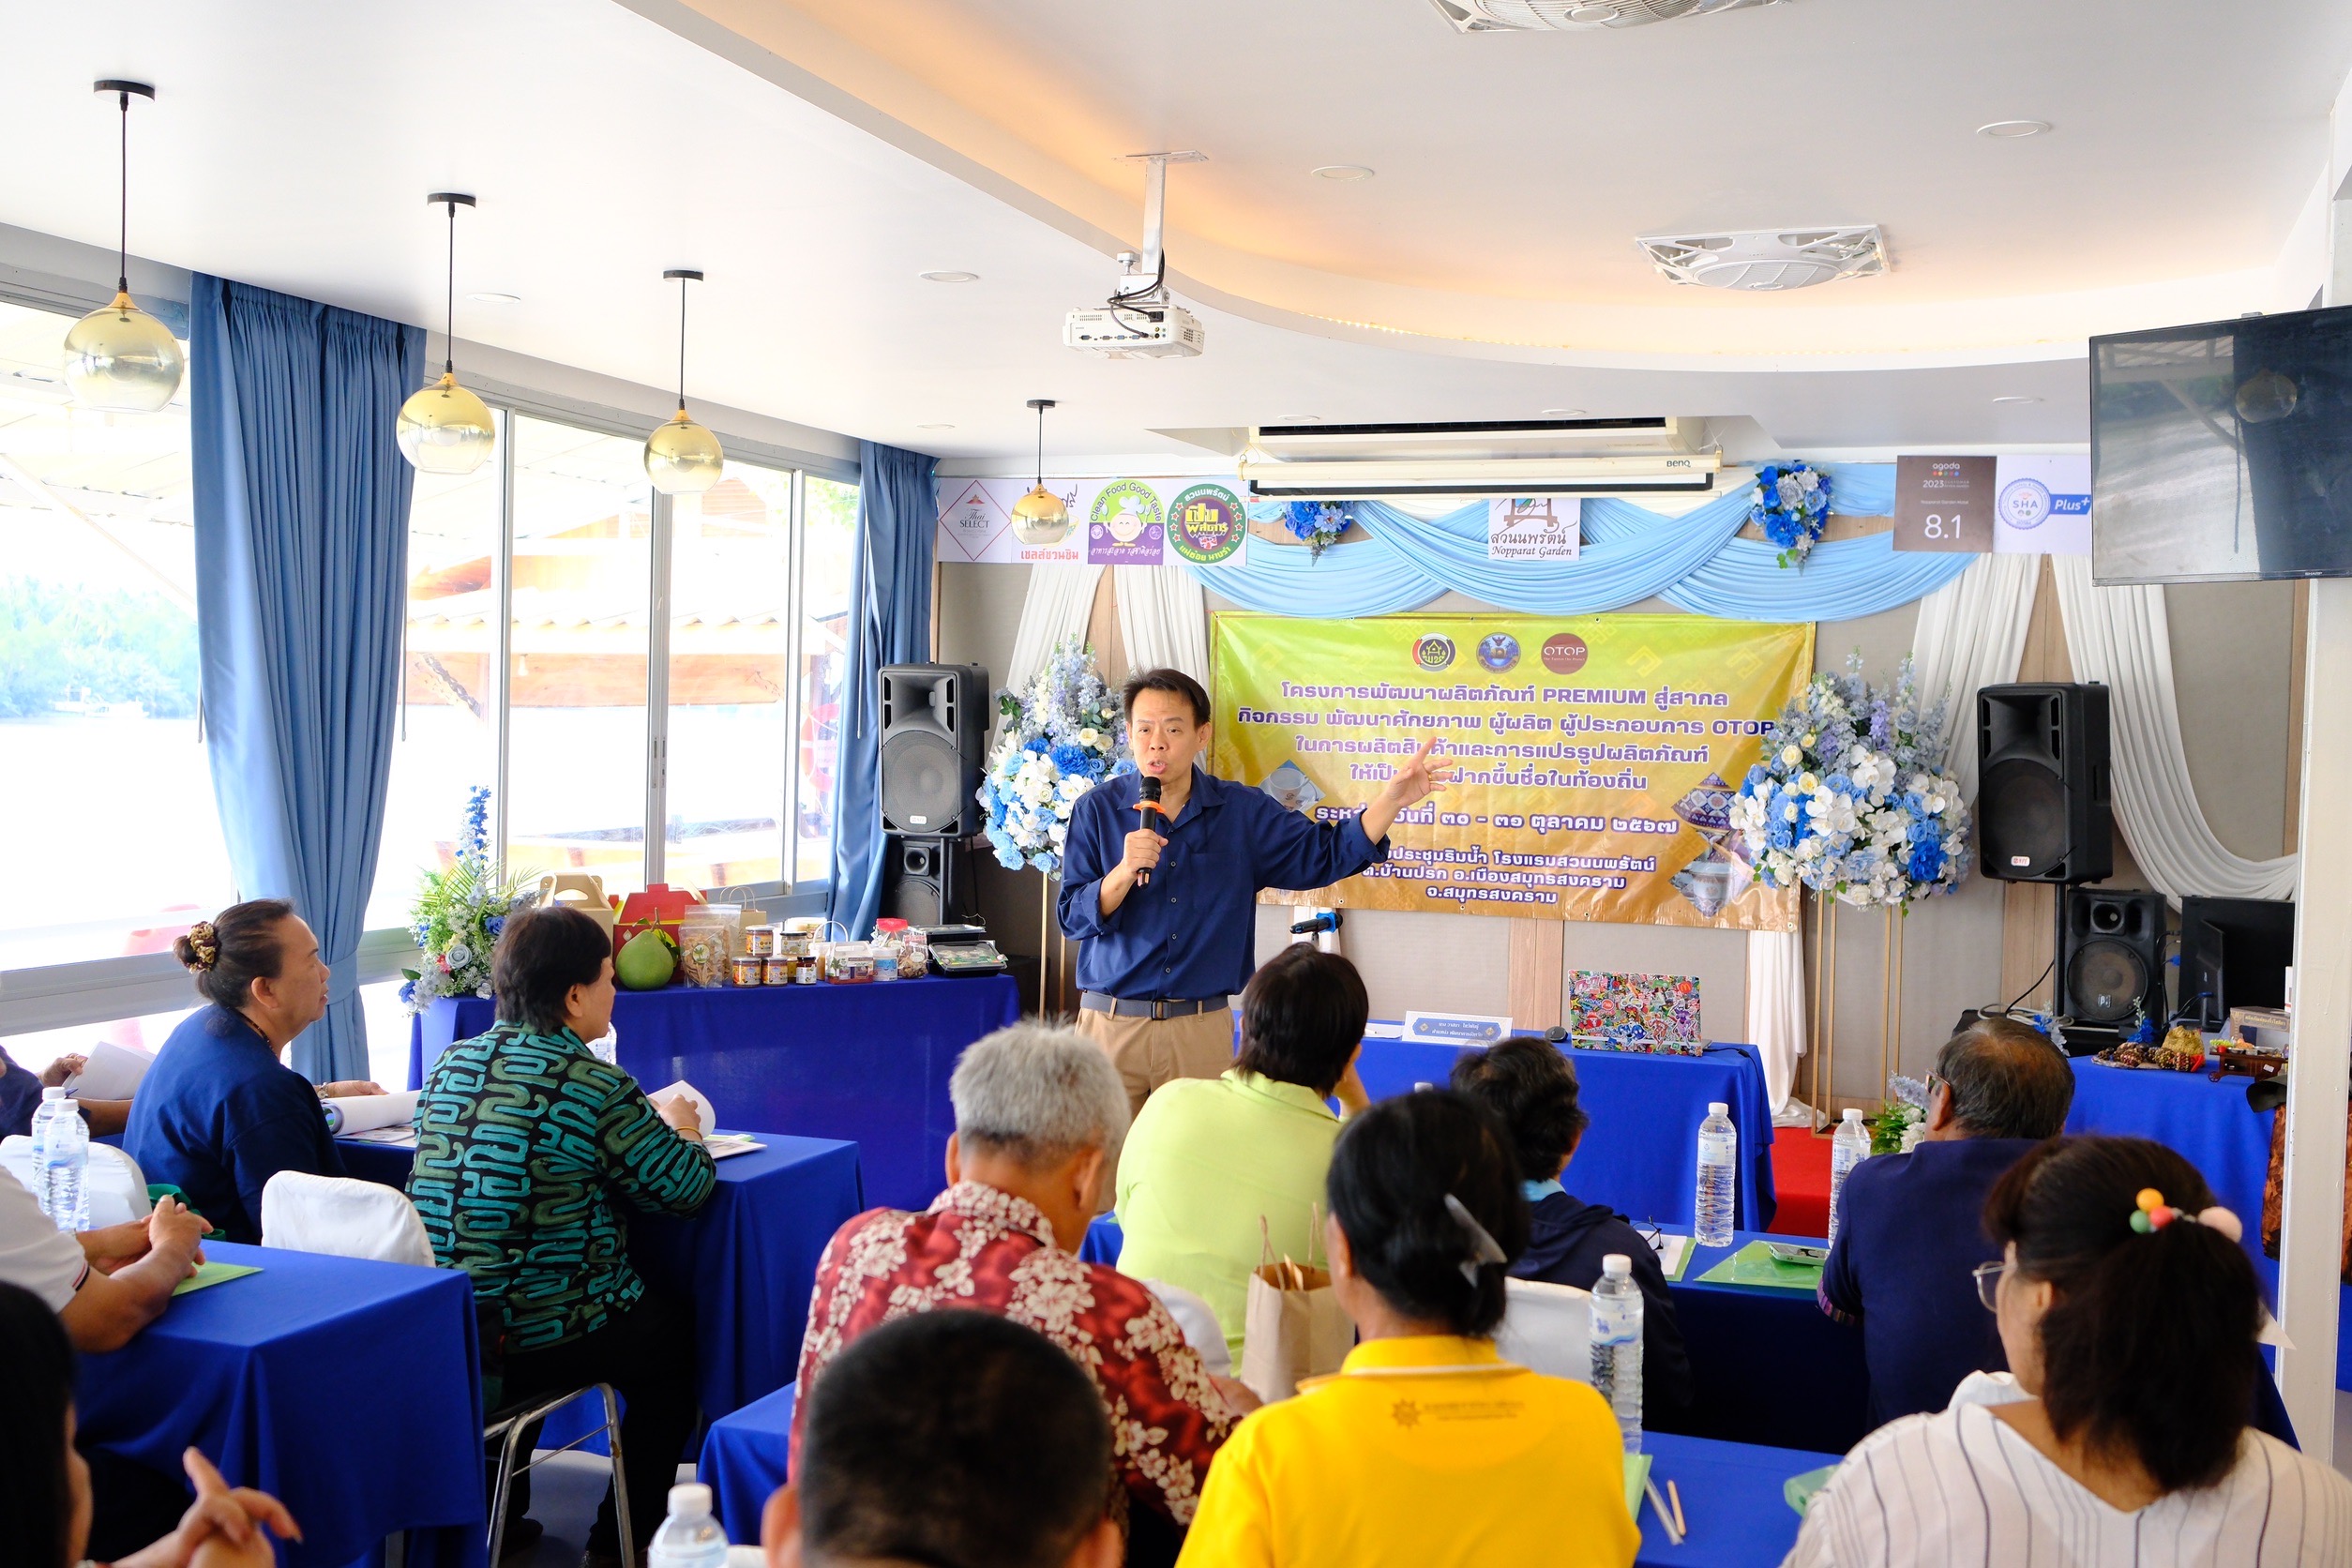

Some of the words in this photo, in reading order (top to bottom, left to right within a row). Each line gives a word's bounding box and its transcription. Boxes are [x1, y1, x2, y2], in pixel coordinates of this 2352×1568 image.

[1932, 462, 1961, 471] agoda
[1090, 496, 1107, 521] Clean
[1106, 481, 1127, 497] Food
[1129, 481, 1152, 499] Good
[1149, 495, 1162, 521] Taste
[2013, 500, 2039, 508] SHA
[966, 508, 986, 520] Thai
[959, 520, 990, 529] SELECT
[1924, 513, 1962, 539] 8.1
[1490, 528, 1568, 546] สวนนพรัตน์
[1020, 548, 1079, 561] เชลล์ชวนชิม
[1491, 545, 1536, 559] Nopparat
[1538, 545, 1573, 559] Garden
[1544, 646, 1586, 656] OTOP
[1281, 680, 1536, 703] โครงการพัฒนาผลิตภัณฑ์
[1543, 687, 1647, 705] PREMIUM
[1653, 686, 1729, 711] สู่สากล
[1237, 706, 1319, 726] กิจกรรม
[1325, 709, 1482, 731] พัฒนาศักยภาพ
[1489, 712, 1553, 736] ผู้ผลิต
[1560, 713, 1704, 738] ผู้ประกอบการ
[1711, 719, 1775, 736] OTOP
[1440, 812, 1470, 826] ๓๐
[1494, 814, 1525, 828] ๓๑
[1530, 813, 1606, 835] ตุลาคม
[1493, 850, 1657, 872] โรงแรมสวนนพรัตน์
[1454, 867, 1627, 890] อ.เมืองสมุทรสงคราม
[1425, 885, 1559, 905] จ.สมุทรสงคราม
